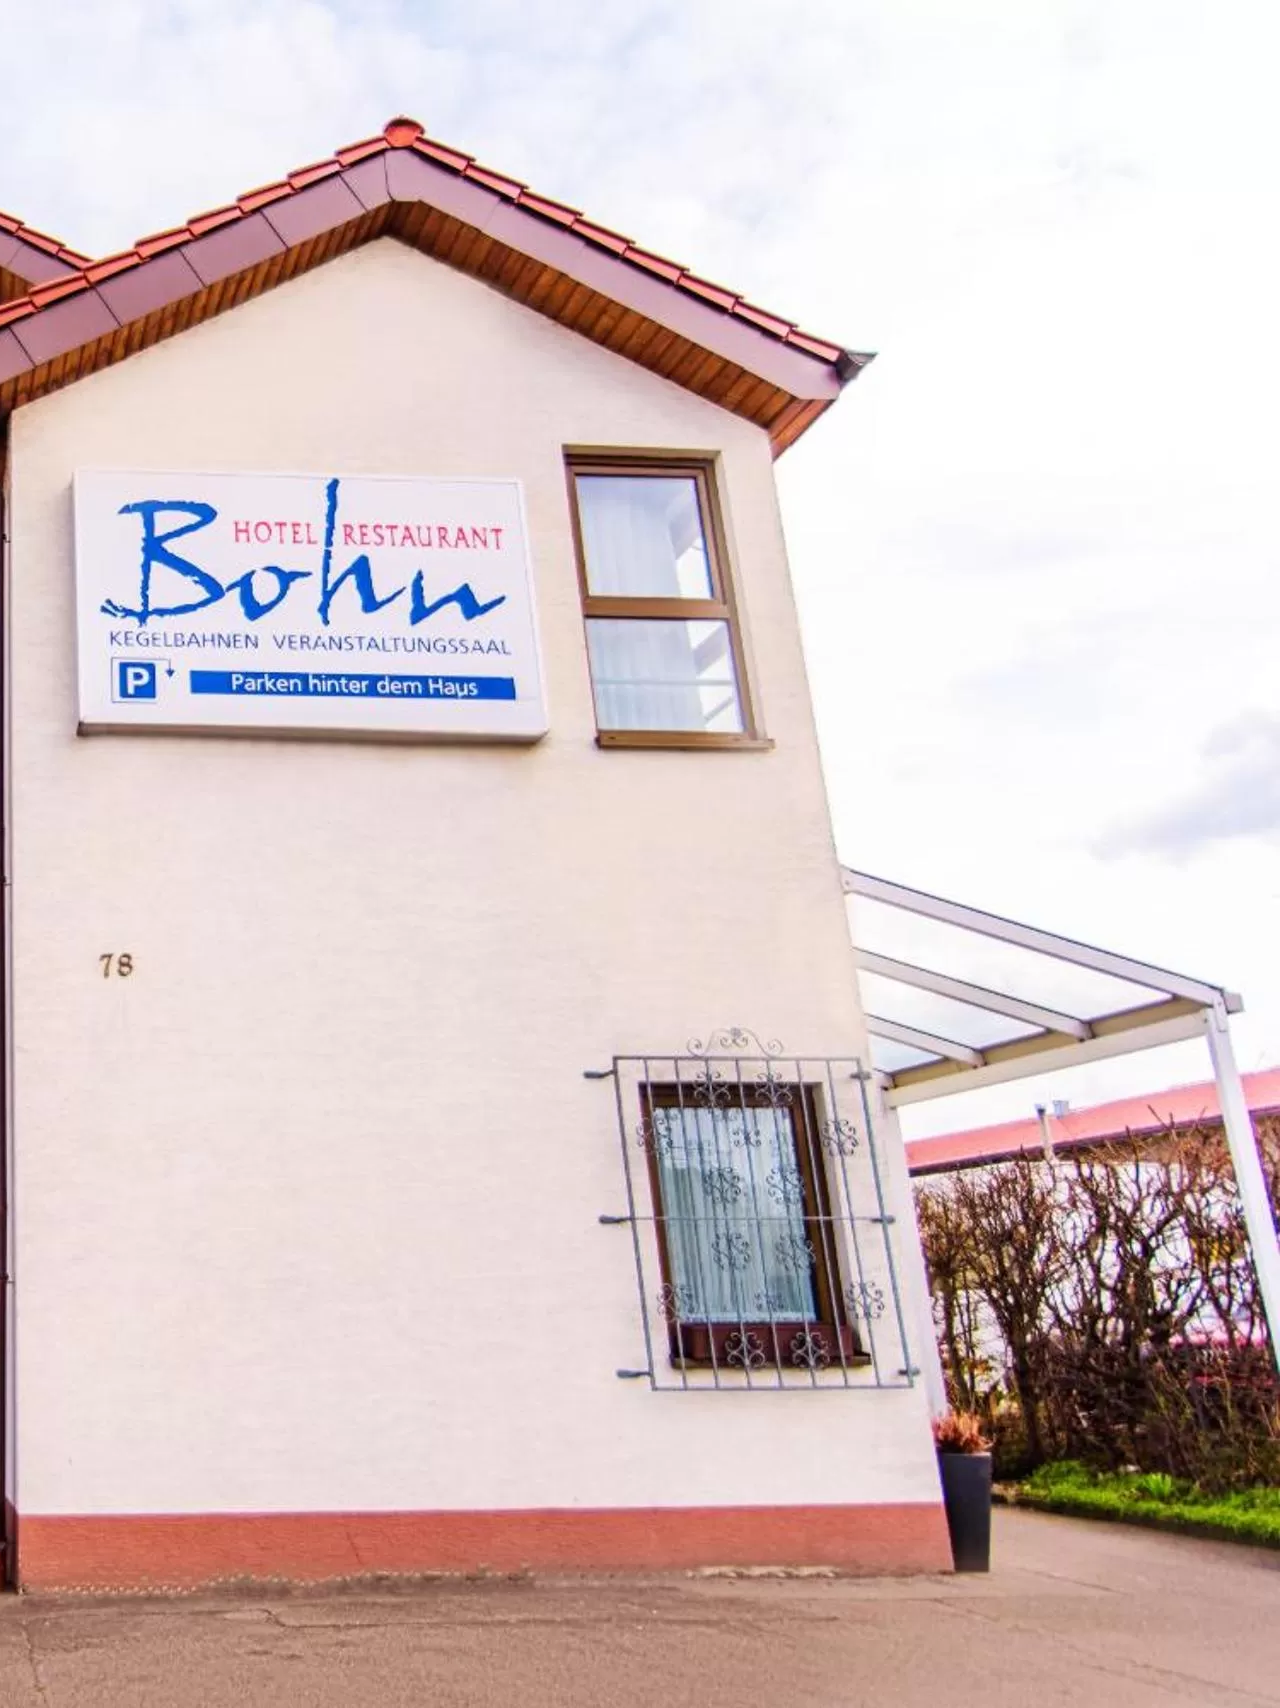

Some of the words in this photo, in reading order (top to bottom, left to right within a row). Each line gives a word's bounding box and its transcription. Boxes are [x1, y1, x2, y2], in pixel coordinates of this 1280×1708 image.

[234, 520, 318, 545] HOTEL
[343, 523, 504, 550] RESTAURANT
[100, 478, 506, 627] Bohn
[110, 631, 259, 649] KEGELBAHNEN
[272, 634, 512, 656] VERANSTALTUNGSSAAL
[126, 667, 150, 695] P
[231, 673, 302, 692] Parken
[308, 675, 369, 693] hinter
[376, 676, 422, 695] dem
[428, 678, 478, 699] Haus
[99, 953, 132, 979] 78
